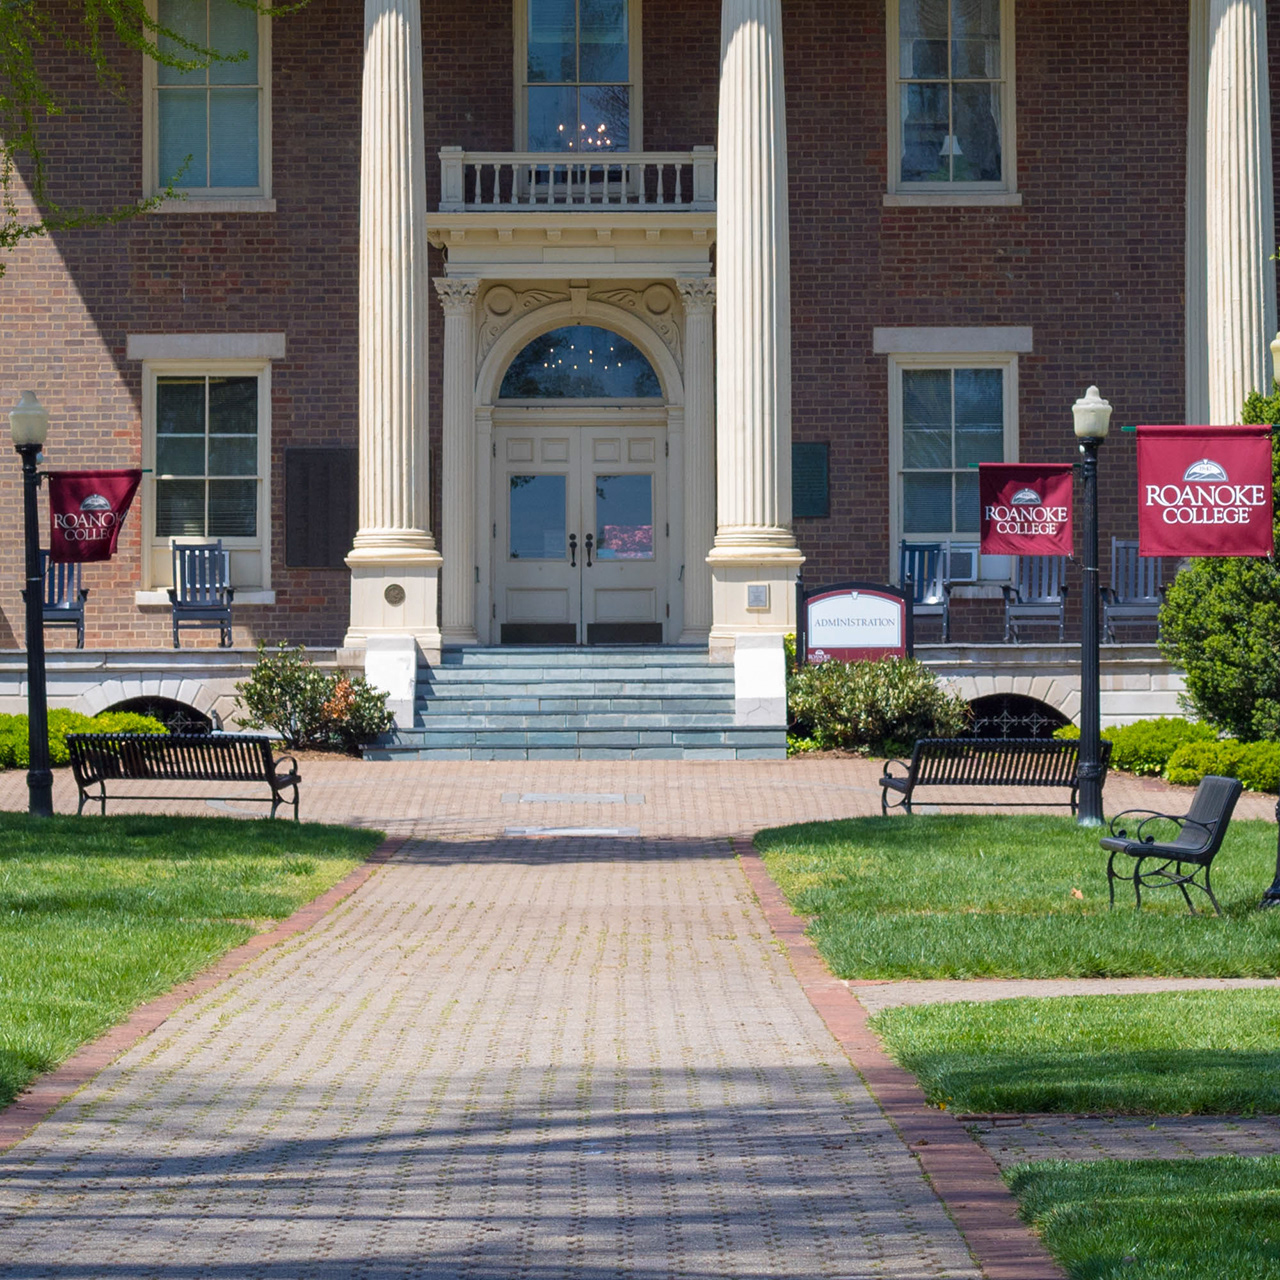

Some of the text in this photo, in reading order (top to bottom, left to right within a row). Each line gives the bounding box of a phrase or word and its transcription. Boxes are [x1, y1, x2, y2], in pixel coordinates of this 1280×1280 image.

[1145, 484, 1266, 506] ROANOKE
[53, 509, 129, 529] ROANOK
[985, 505, 1068, 522] ROANOKE
[1162, 506, 1250, 524] COLLEGE
[64, 528, 111, 541] COLLE
[996, 521, 1058, 535] COLLEGE
[814, 618, 896, 627] ADMINISTRATION
